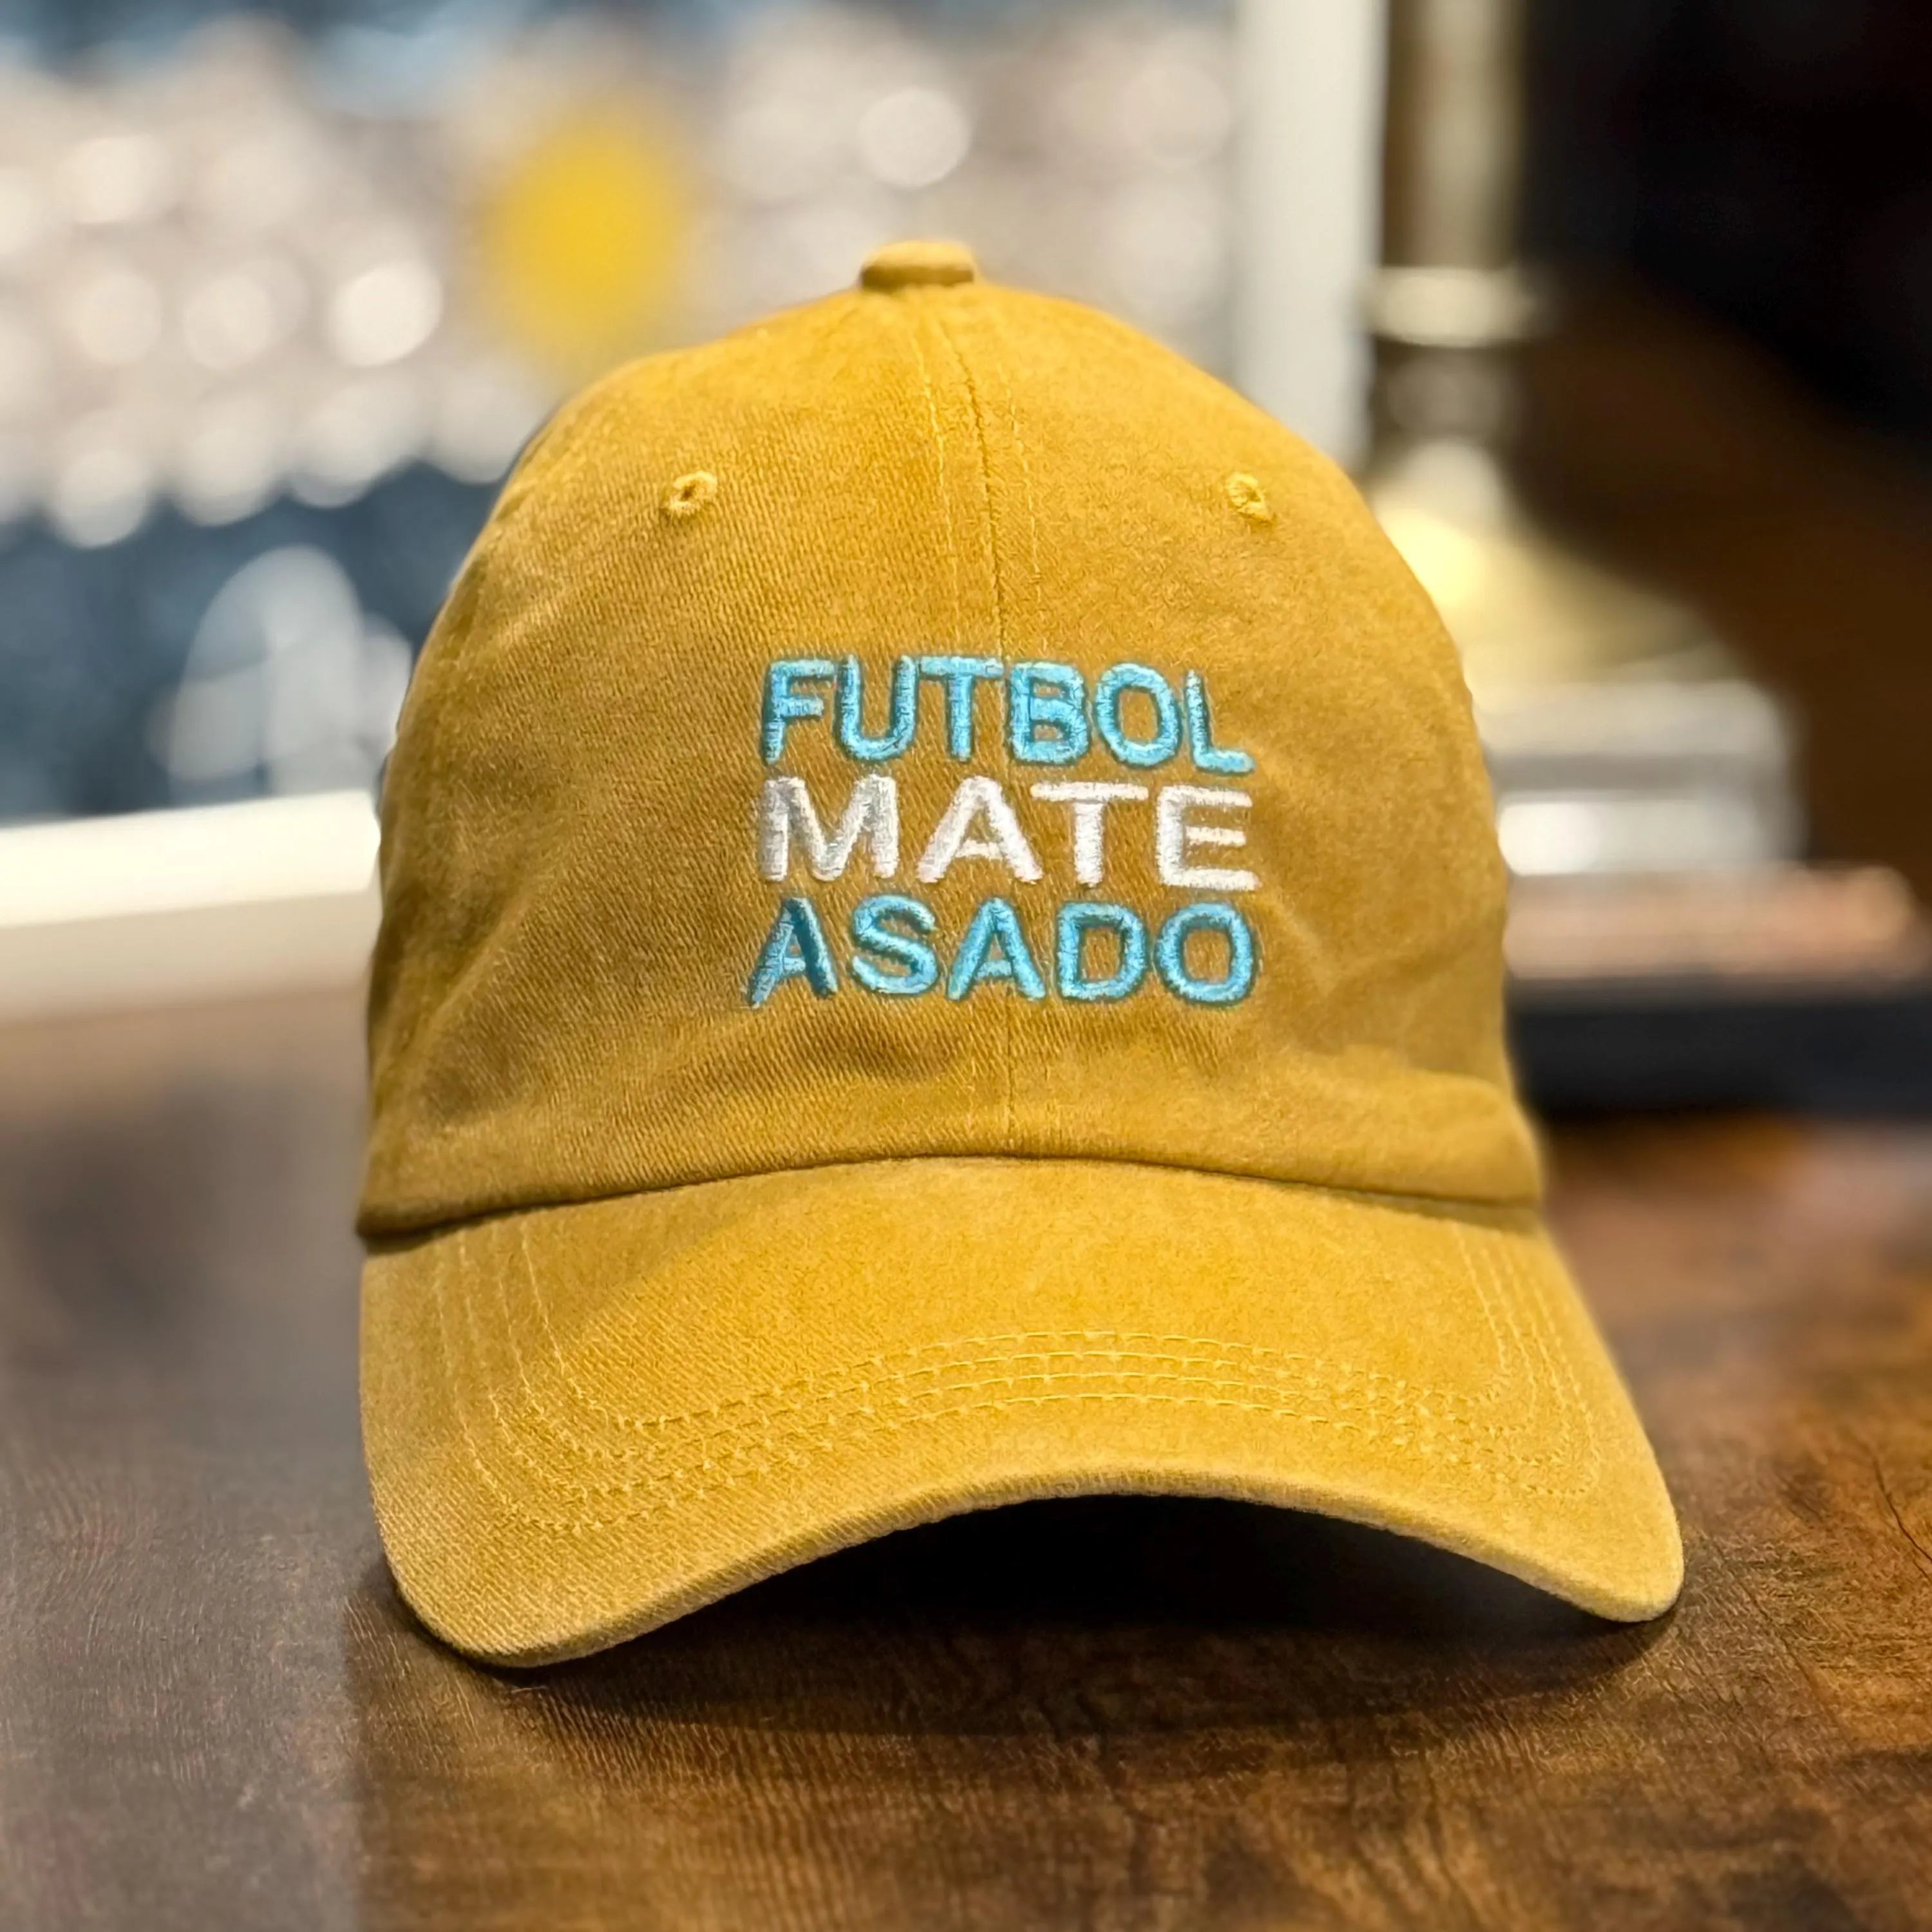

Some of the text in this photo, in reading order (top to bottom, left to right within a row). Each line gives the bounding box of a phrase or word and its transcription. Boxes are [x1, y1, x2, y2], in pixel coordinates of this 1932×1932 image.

[762, 655, 1255, 774] FUTBOL
[761, 774, 1258, 890] MATE
[749, 897, 1257, 1008] ASADO
